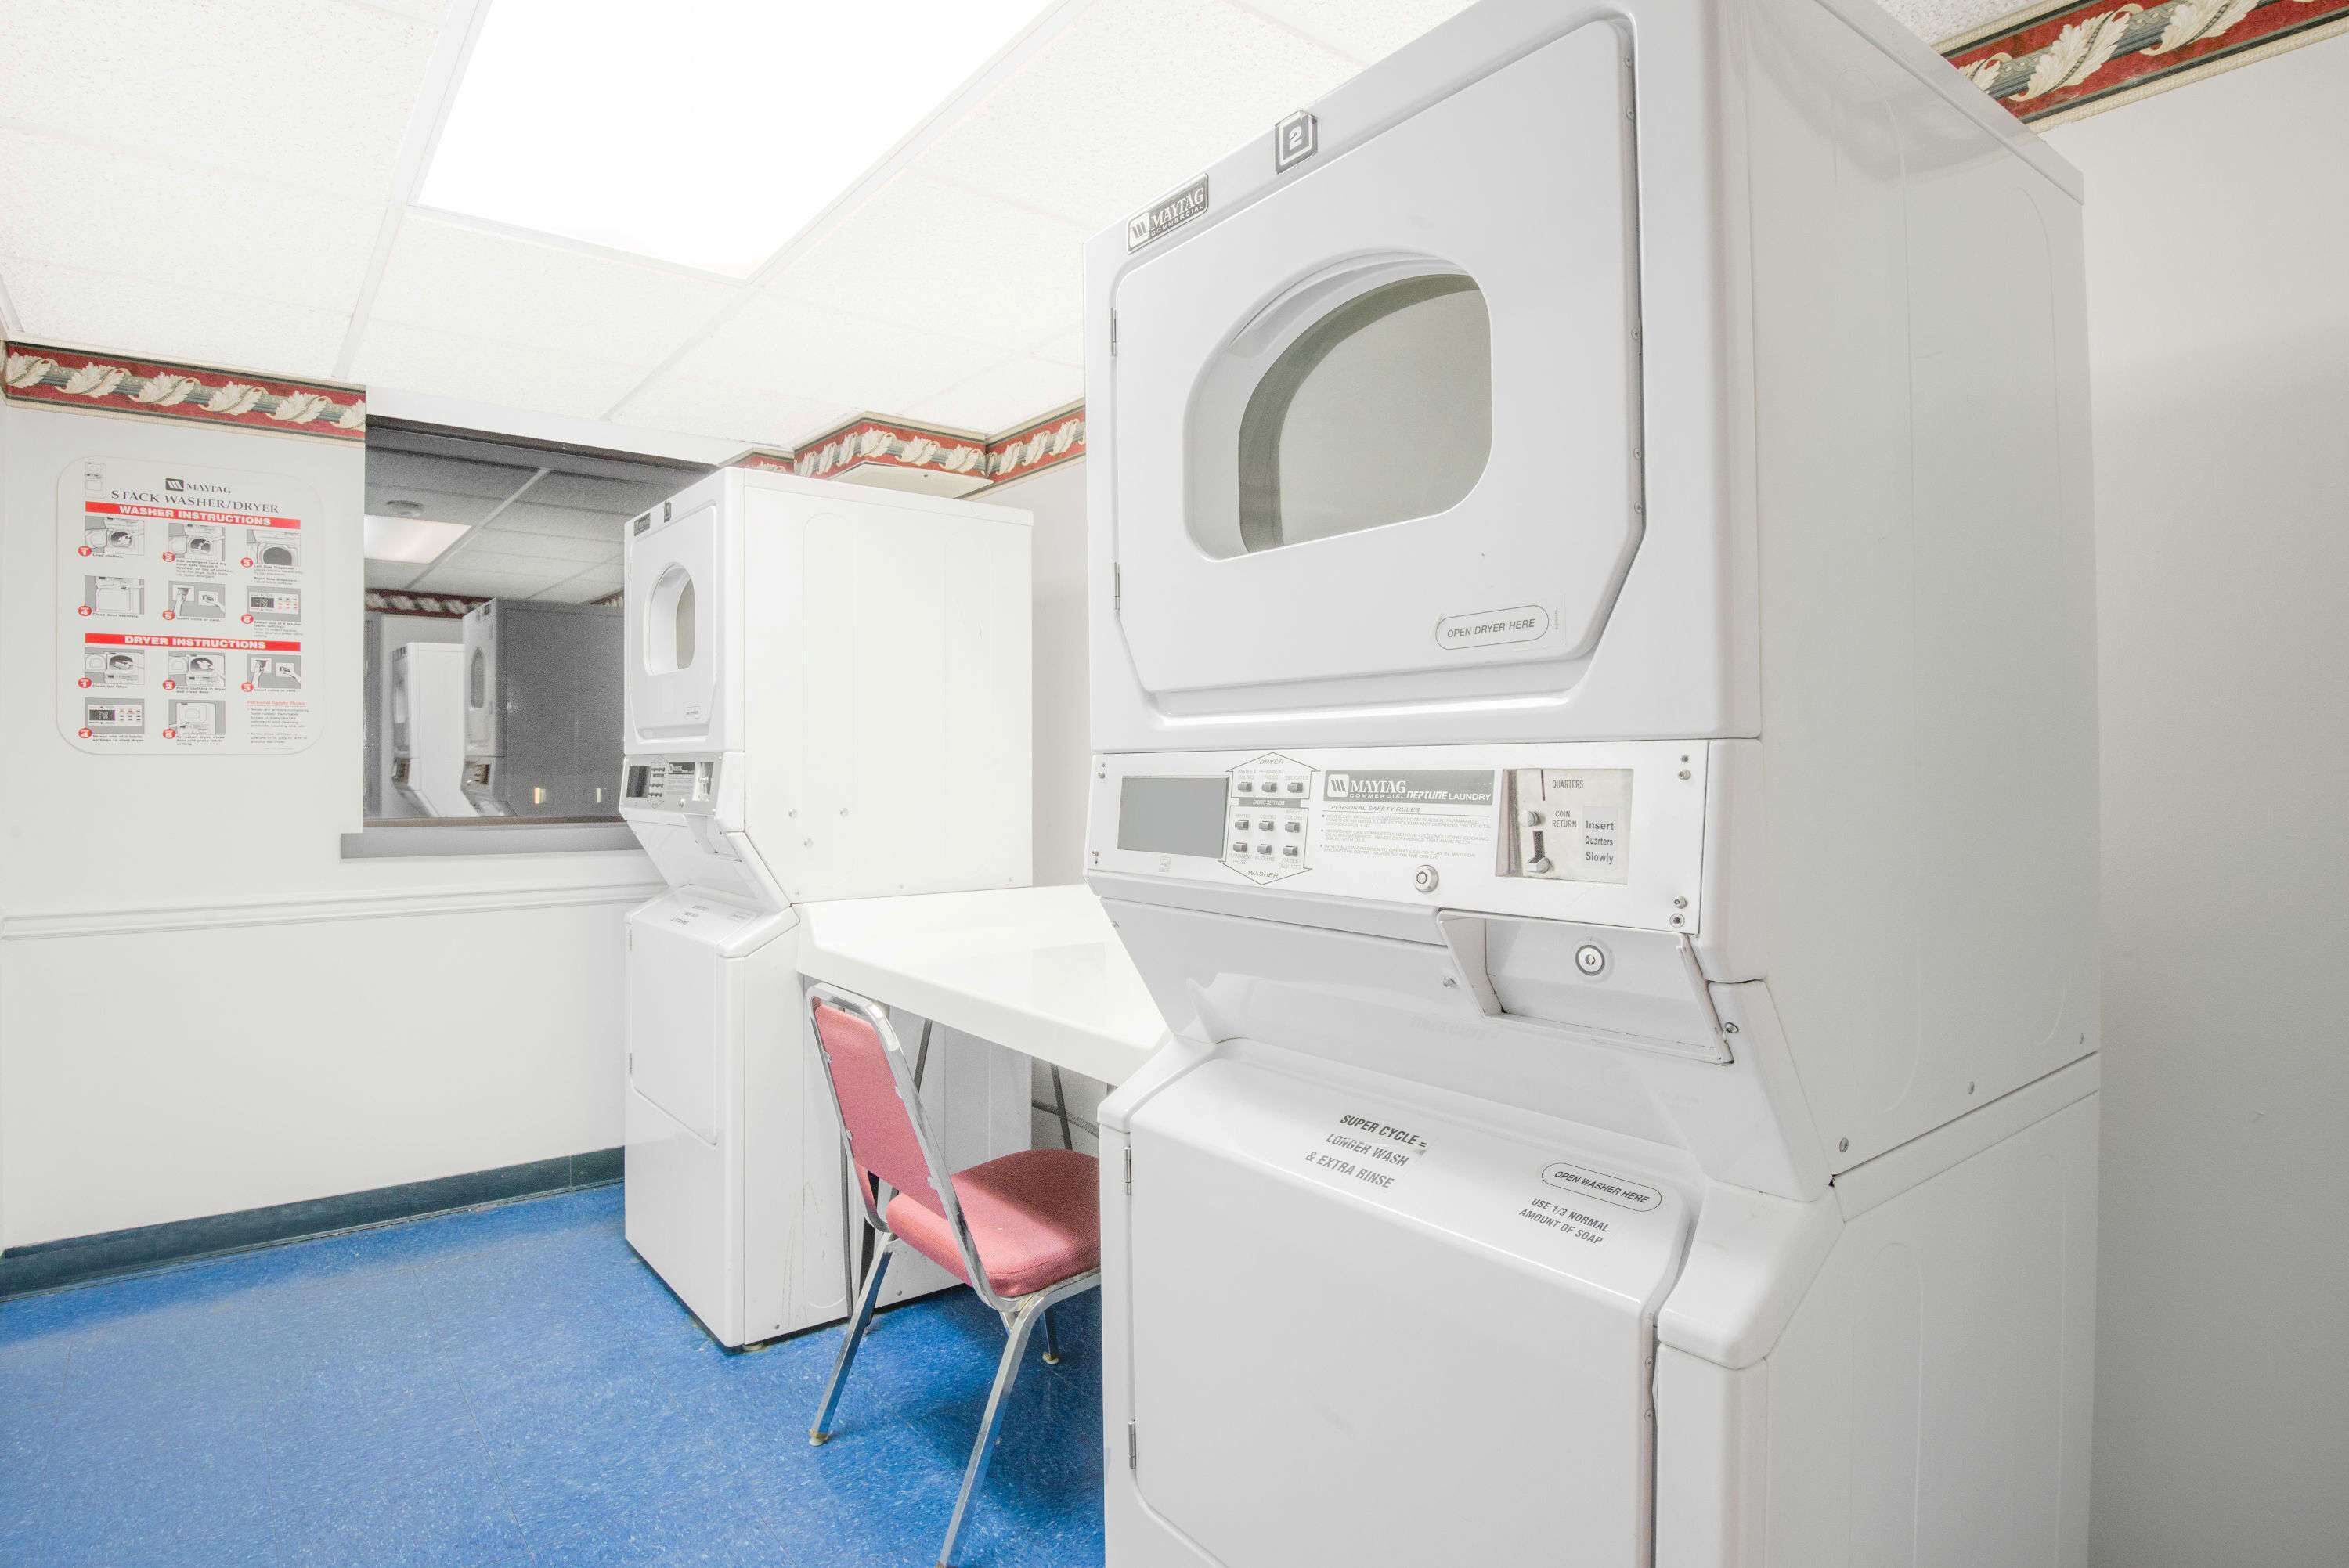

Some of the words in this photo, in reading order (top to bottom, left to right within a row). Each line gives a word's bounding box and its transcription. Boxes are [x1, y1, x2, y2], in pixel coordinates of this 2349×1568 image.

[1289, 125, 1303, 150] 2
[1150, 187, 1203, 231] MAYTAG
[1151, 204, 1203, 236] COMMERCIAL
[187, 483, 231, 494] MAYTAG
[111, 490, 159, 503] STACK
[164, 494, 279, 514] WASHER/DRYER
[119, 505, 174, 517] WASHER
[178, 511, 271, 525] INSTRUCTIONS
[1447, 628, 1471, 638] OPEN
[1474, 622, 1506, 635] DRYER
[1509, 618, 1535, 629] HERE
[125, 636, 168, 645] DRYER
[172, 638, 266, 650] INSTRUCTIONS
[1350, 780, 1406, 793] MAYTAG
[1552, 780, 1584, 789] QUARTERS
[1586, 820, 1615, 831] Insert
[1585, 835, 1614, 846] Quarters
[1586, 852, 1614, 865] Slowly
[1340, 1114, 1380, 1133] SUPER
[1378, 1126, 1420, 1145] CYCLE
[1325, 1134, 1372, 1155] LONGER
[1372, 1147, 1409, 1166] WASH
[1305, 1151, 1317, 1162] &
[1316, 1155, 1356, 1176] EXTRA
[1355, 1168, 1395, 1188] RINSE
[1554, 1171, 1582, 1183] OPEN
[1580, 1177, 1622, 1195] WASHER
[1620, 1189, 1650, 1203] HERE
[1519, 1209, 1561, 1228] AMOUNT
[1560, 1224, 1575, 1234] OF
[1575, 1229, 1603, 1245] SOAP
[1531, 1198, 1551, 1210] USE
[1552, 1206, 1568, 1216] 1/3
[1568, 1211, 1611, 1232] NORMAL
